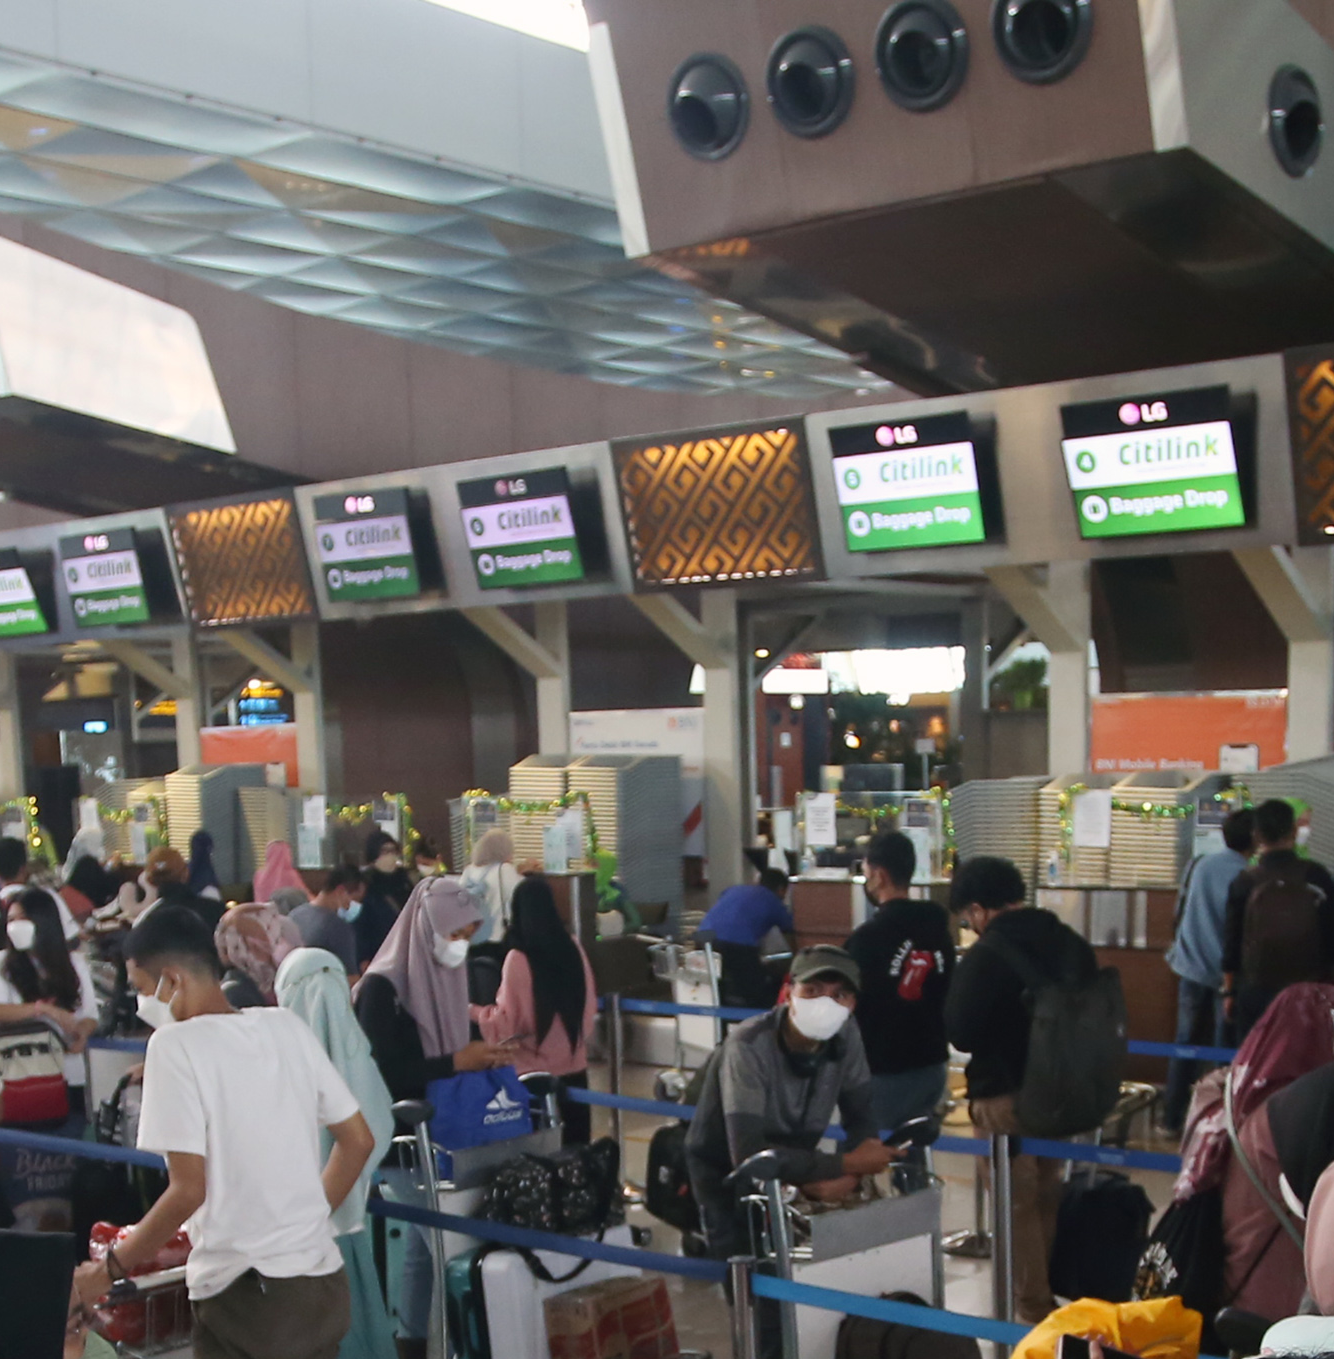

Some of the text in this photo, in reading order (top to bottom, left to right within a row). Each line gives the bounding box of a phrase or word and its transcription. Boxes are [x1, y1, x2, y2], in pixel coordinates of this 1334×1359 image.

[1140, 401, 1168, 422] LG
[893, 425, 918, 445] LG
[1119, 434, 1219, 465] Citilink
[880, 453, 964, 483] Citilink
[508, 479, 527, 496] LG
[357, 495, 375, 513] LG
[1108, 489, 1229, 517] Baggage Drop
[497, 508, 562, 531] Citilink
[871, 506, 972, 532] Baggage Drop
[345, 525, 402, 548] Citilink
[87, 558, 132, 580] Citilink
[496, 549, 572, 570] Baggage Drop
[1119, 759, 1156, 770] Mobile
[483, 1108, 523, 1125] adidas
